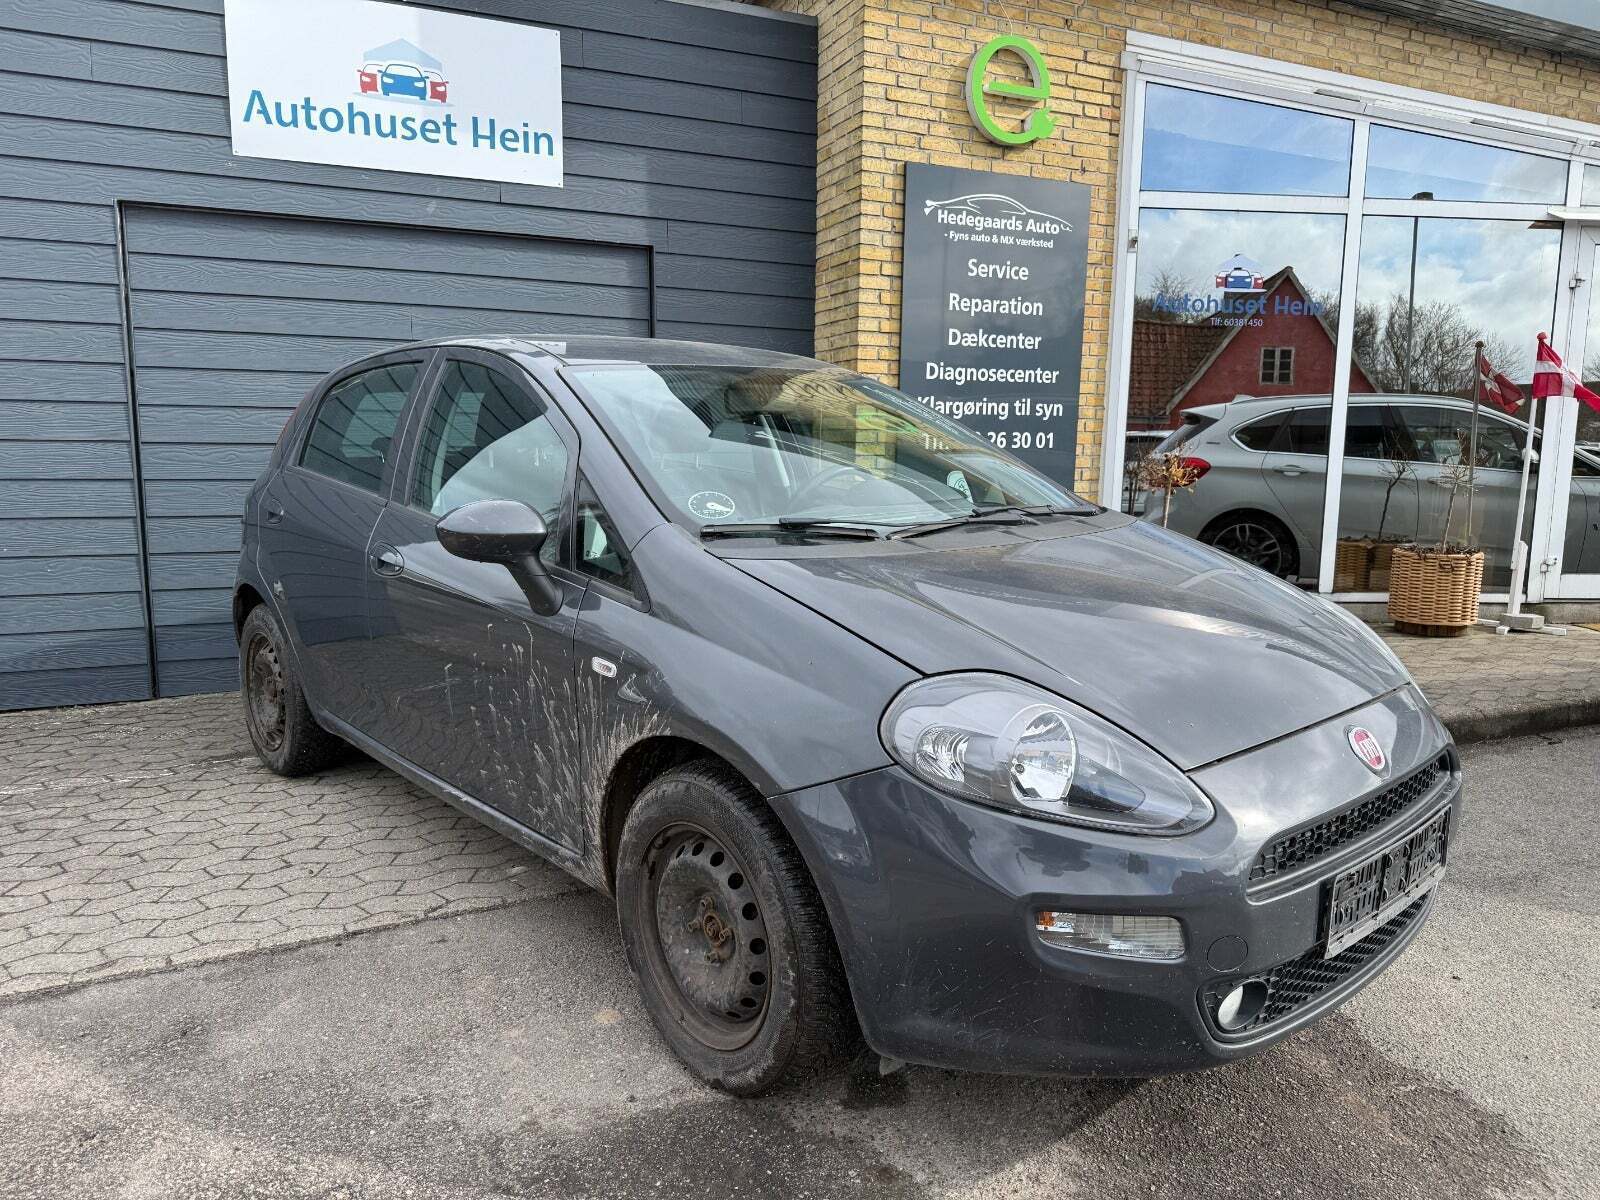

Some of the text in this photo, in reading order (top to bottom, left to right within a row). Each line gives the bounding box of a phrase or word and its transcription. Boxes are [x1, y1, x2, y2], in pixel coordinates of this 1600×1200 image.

[243, 89, 554, 156] Autohuset Hein
[937, 209, 1060, 235] Hedegaards Auto
[949, 231, 1054, 249] Fyns auto & MX værksted
[967, 258, 1029, 281] Service
[948, 292, 1043, 317] Reparation
[1151, 292, 1326, 316] Autohuset Hein
[1211, 317, 1263, 327] Tlf: 60381450
[948, 328, 1042, 350] Dækcenter
[925, 361, 1060, 386] Diagnosecenter
[1014, 398, 1030, 417] til
[1035, 403, 1063, 421] syn
[1011, 431, 1032, 449] 30
[1035, 431, 1054, 449] 01
